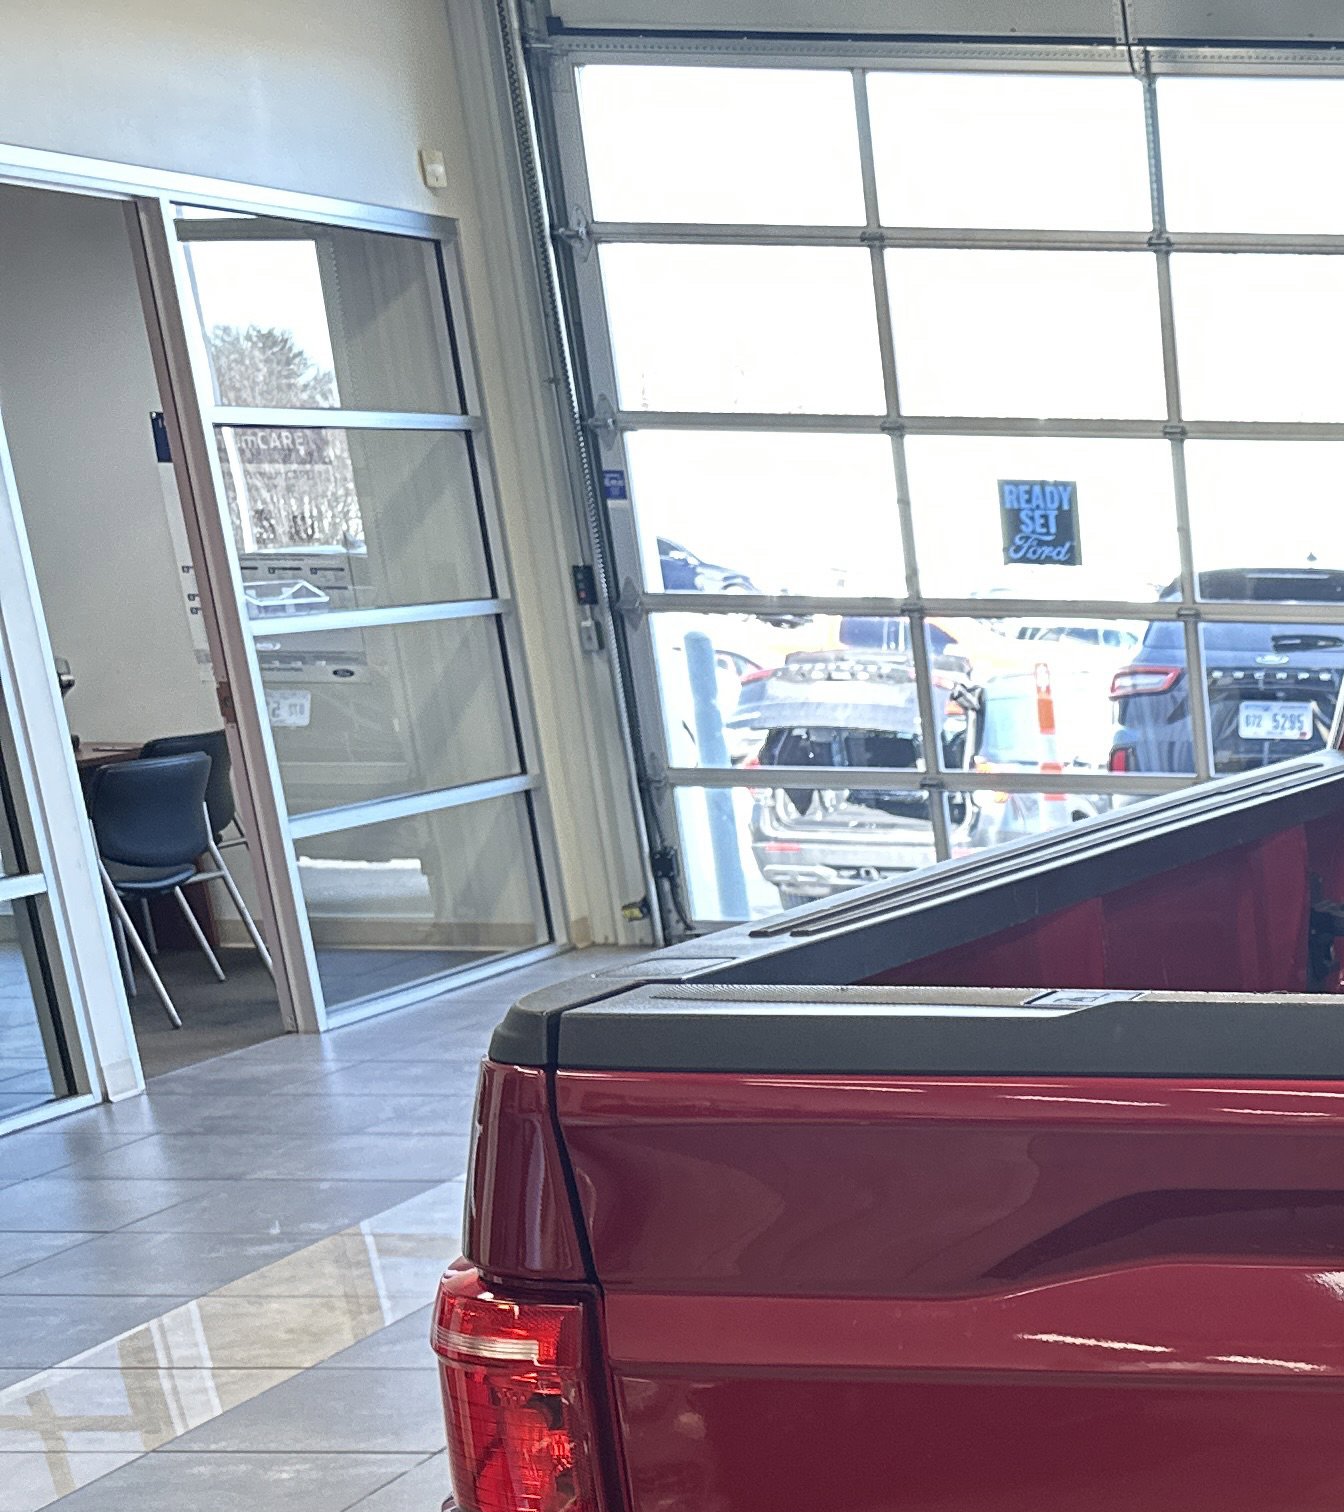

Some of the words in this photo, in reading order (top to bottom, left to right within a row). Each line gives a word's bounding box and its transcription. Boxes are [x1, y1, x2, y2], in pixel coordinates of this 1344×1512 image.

[1003, 484, 1072, 510] READY
[1019, 509, 1058, 534] SET
[1008, 533, 1072, 561] Ford
